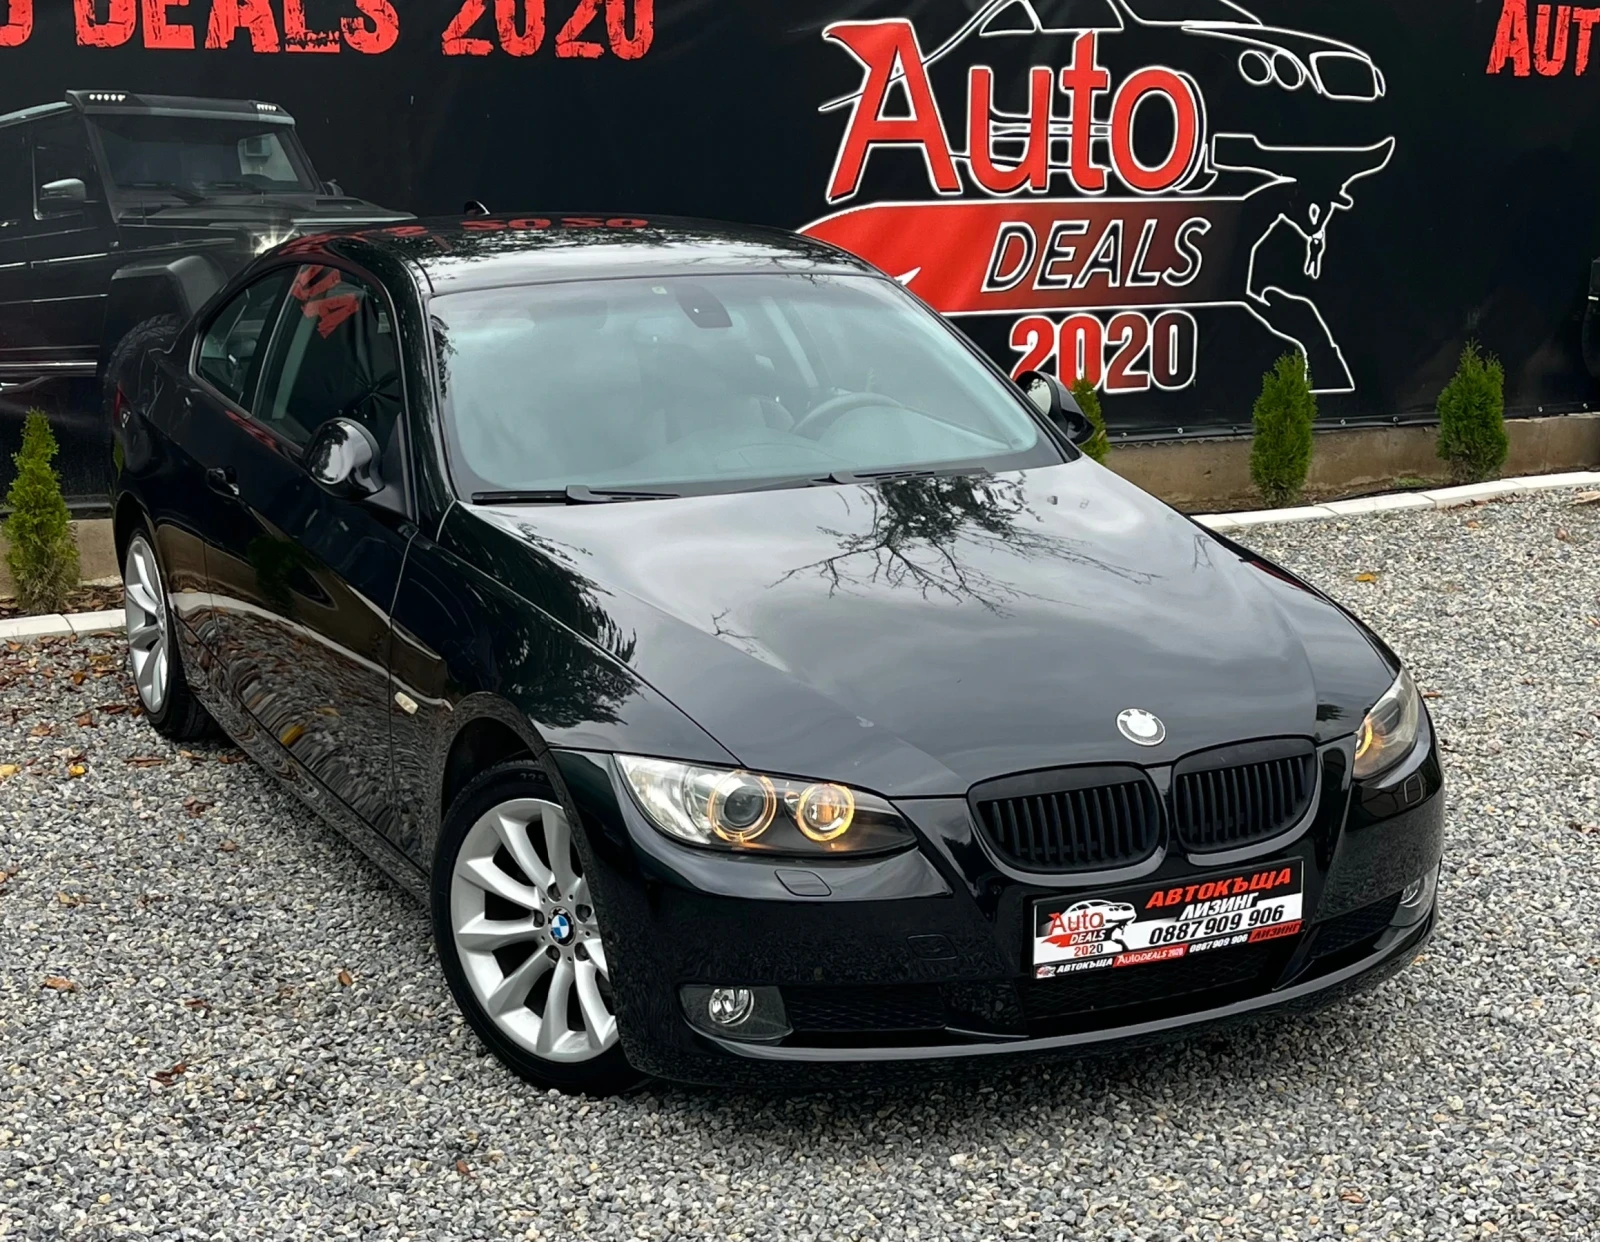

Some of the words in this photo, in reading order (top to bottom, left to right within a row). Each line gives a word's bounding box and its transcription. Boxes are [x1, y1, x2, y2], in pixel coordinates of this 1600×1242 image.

[822, 18, 1204, 202] Auto
[981, 216, 1212, 293] DEALS
[1009, 309, 1198, 393] 2020
[1145, 868, 1292, 909] АВТОКЪЩА
[1178, 892, 1259, 920] ЛИЗИНГ
[1248, 905, 1285, 927] 906
[1048, 909, 1105, 936] Auto
[1252, 923, 1300, 940] ЛИЗИНГ
[1069, 929, 1106, 945] DEALS
[1074, 943, 1104, 957] 2020
[1056, 957, 1114, 974] АВТОКЪЩА
